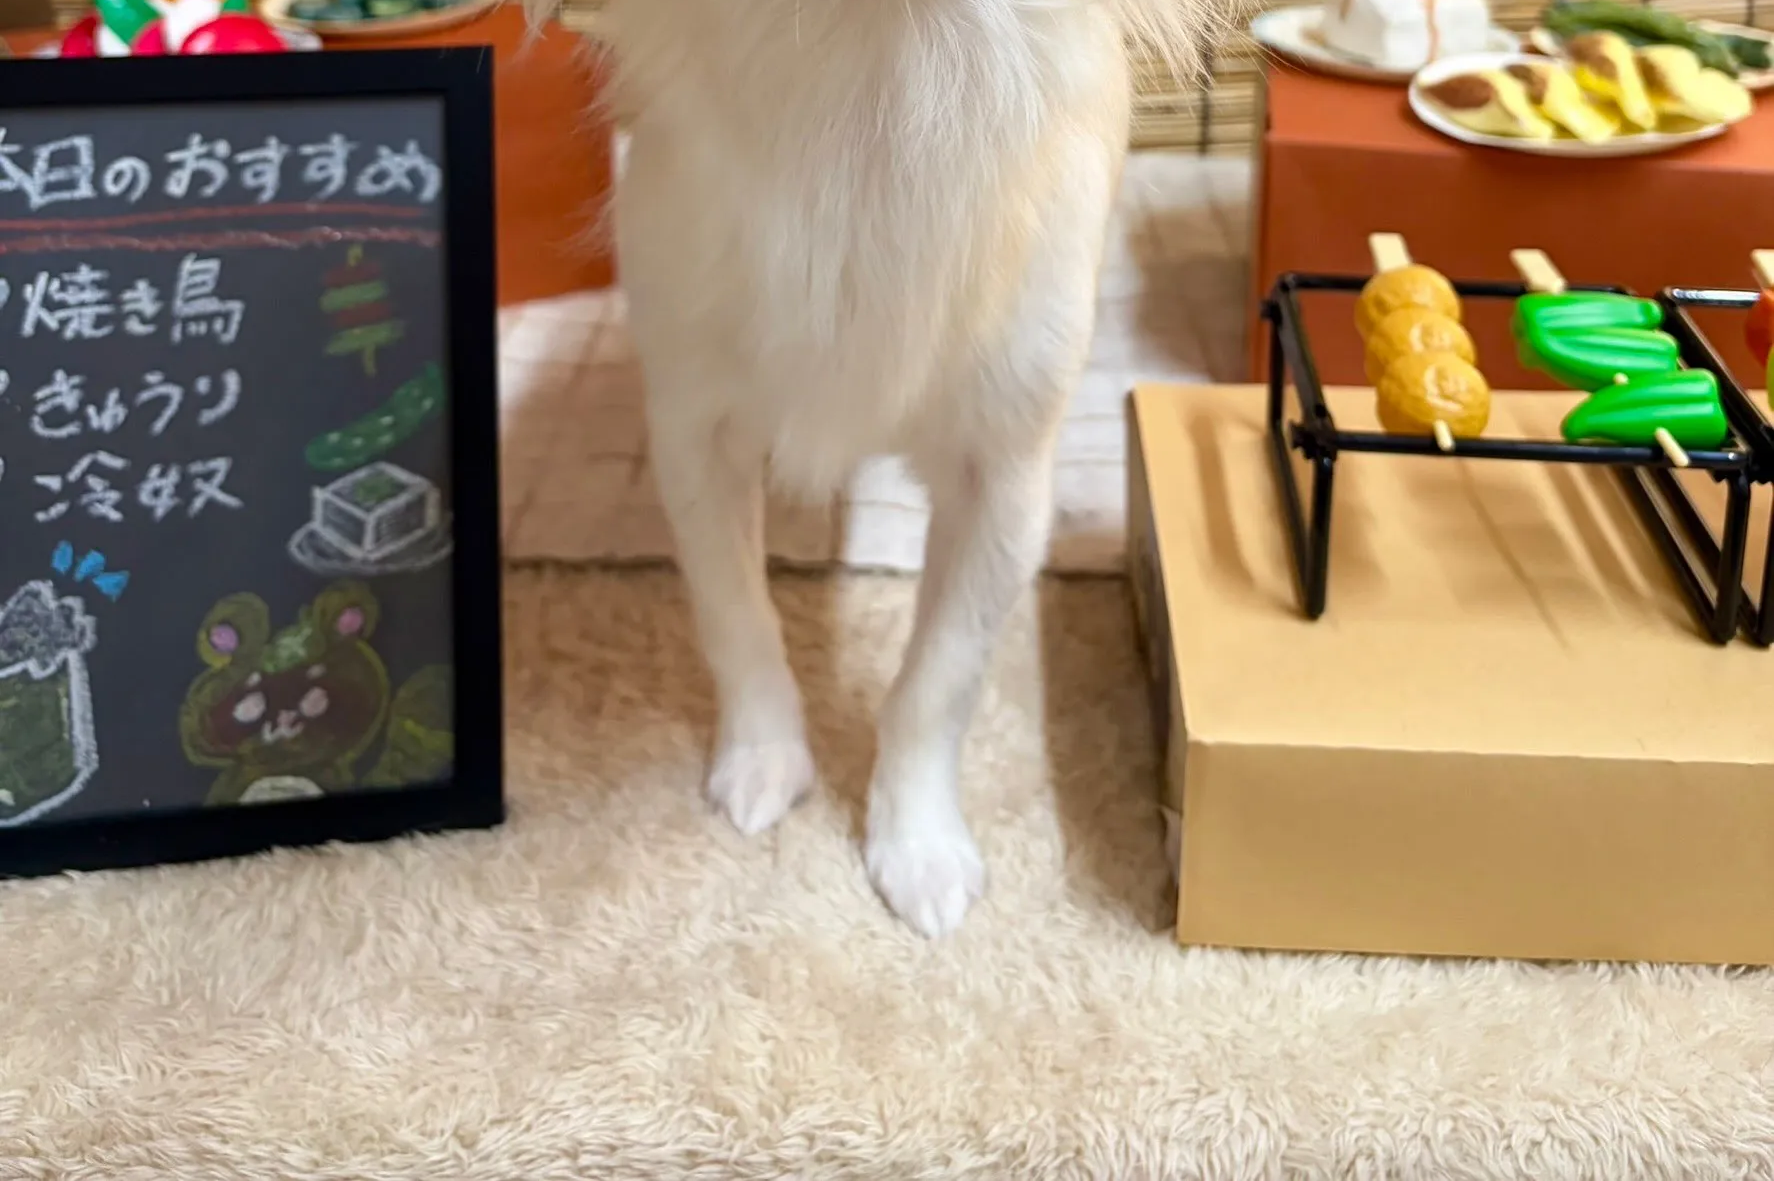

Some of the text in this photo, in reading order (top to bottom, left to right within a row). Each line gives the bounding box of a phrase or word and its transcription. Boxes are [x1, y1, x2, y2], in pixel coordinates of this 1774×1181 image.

[20, 252, 246, 345] 焼き鳥
[29, 369, 241, 438] きゅうり
[33, 449, 244, 522] 冷奴
